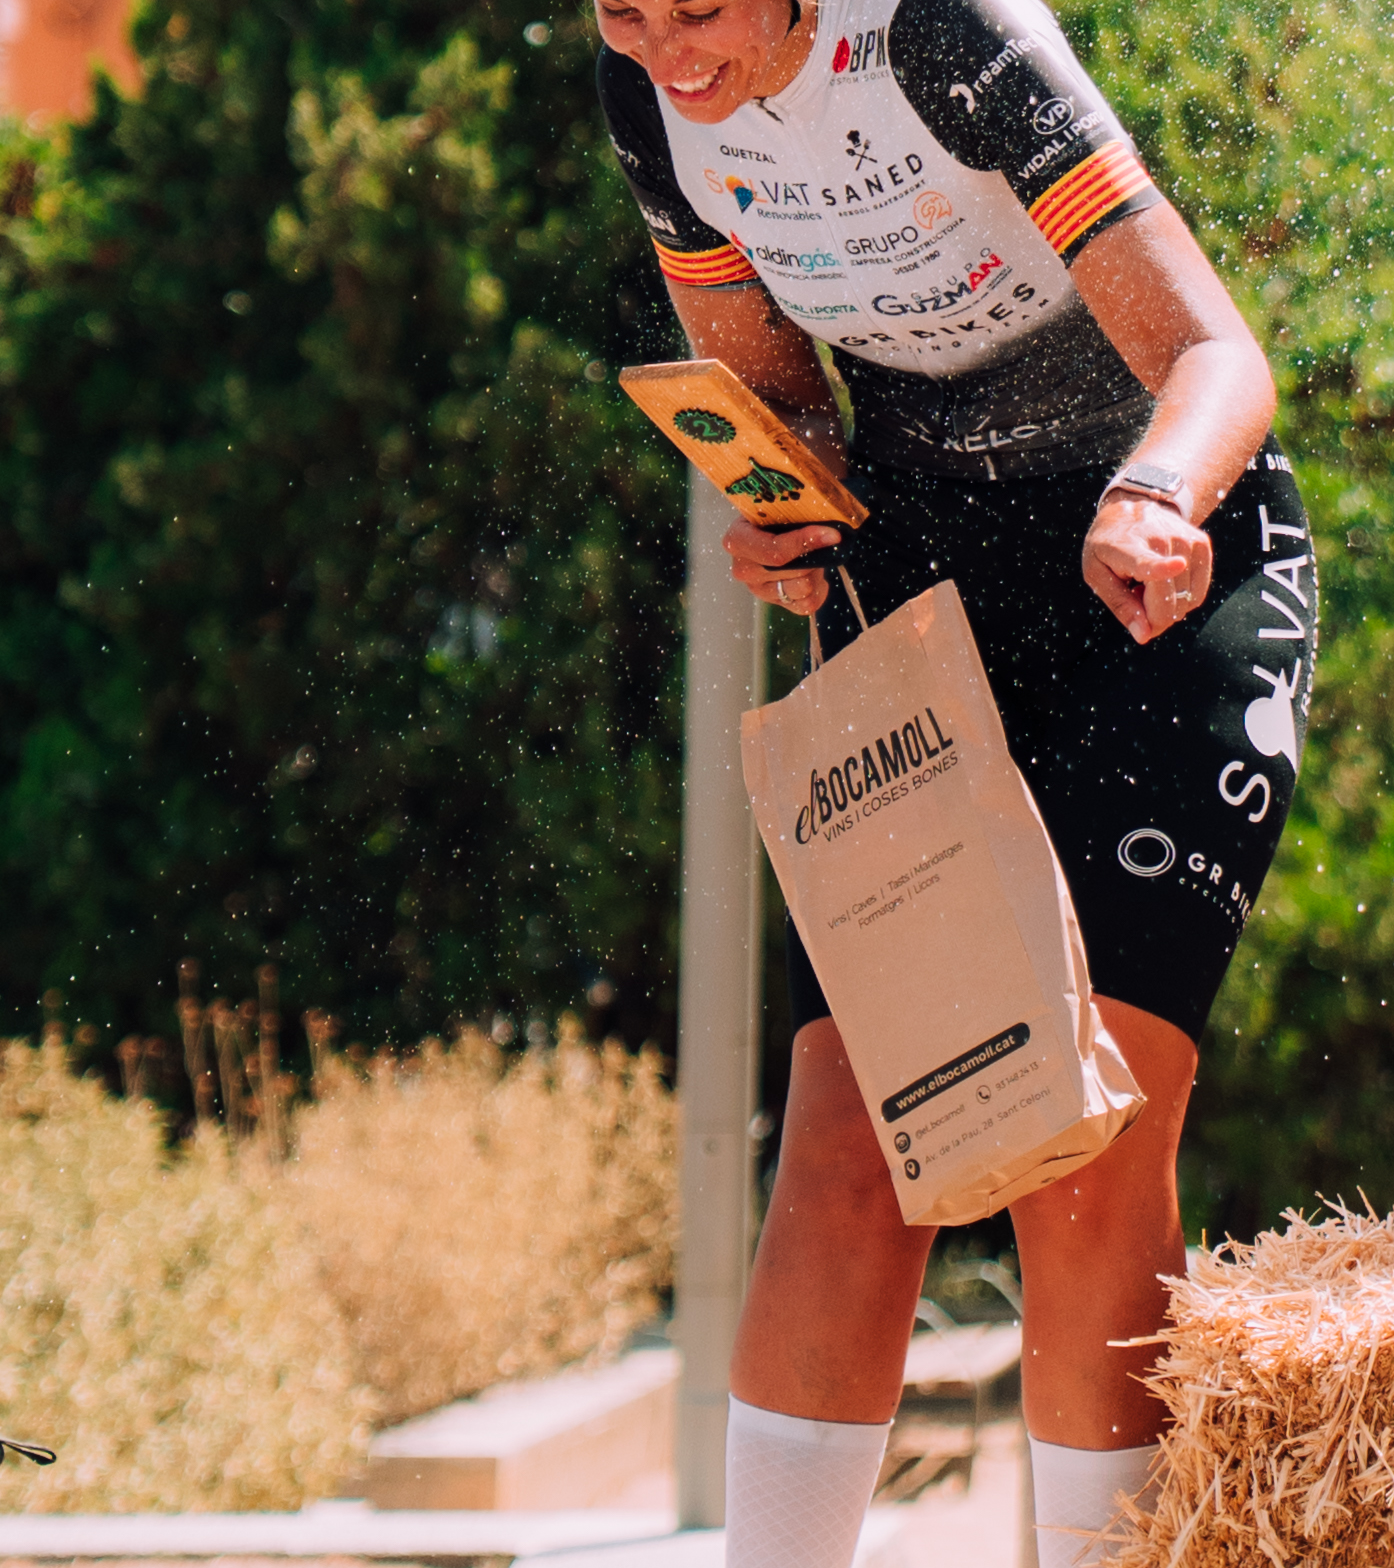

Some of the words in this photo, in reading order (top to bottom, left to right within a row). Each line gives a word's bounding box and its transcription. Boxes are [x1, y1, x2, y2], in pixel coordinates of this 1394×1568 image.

[1040, 103, 1067, 127] VP
[720, 145, 777, 164] QUETZAL
[1018, 139, 1067, 180] VIDAL
[1069, 111, 1105, 137] PORT
[821, 153, 923, 207] SANED
[757, 208, 822, 221] Renovables
[844, 225, 919, 255] GRUPO
[894, 217, 966, 262] CONSTRUCTORA
[909, 282, 1036, 340] BIKES
[823, 815, 854, 842] VINS
[862, 782, 909, 817] COSES
[912, 751, 958, 789] BONES
[852, 894, 877, 915] Caves
[914, 841, 964, 875] Maridatges
[1188, 852, 1222, 885] GR
[858, 895, 904, 929] Formatges
[914, 873, 941, 894] Licors
[896, 1034, 1016, 1110] www.elbocamoll.cat
[939, 1143, 951, 1156] de
[983, 1117, 994, 1131] 28
[997, 1105, 1019, 1122] Sant
[1019, 1085, 1052, 1109] Celoni
